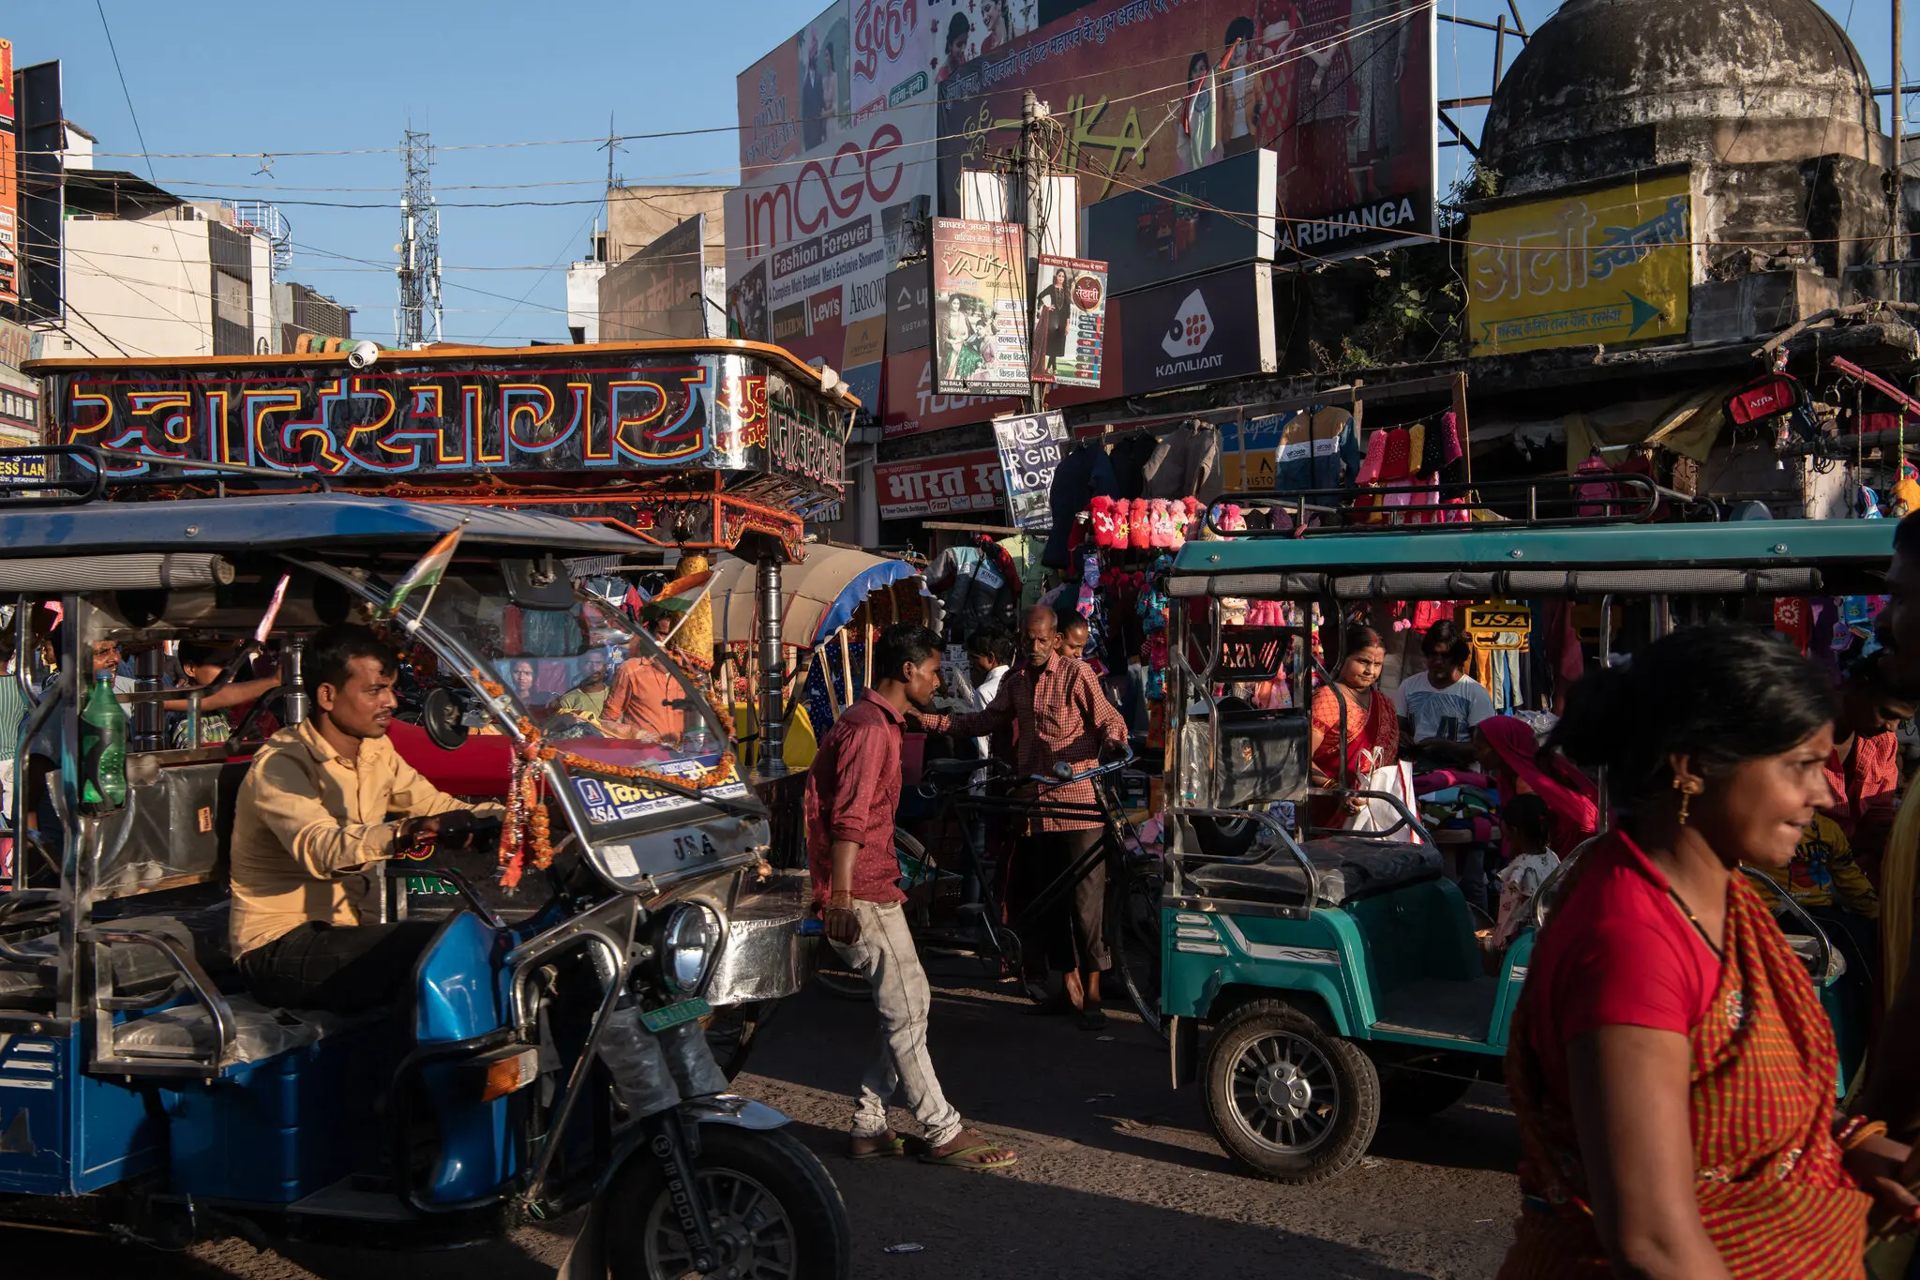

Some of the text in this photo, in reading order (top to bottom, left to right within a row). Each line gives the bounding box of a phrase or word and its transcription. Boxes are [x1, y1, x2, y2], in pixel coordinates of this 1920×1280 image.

[1082, 16, 1094, 43] के
[1094, 12, 1116, 46] शुभ
[774, 221, 870, 277] Fashion Forever
[848, 277, 887, 315] ARROW
[1076, 285, 1099, 301] सेठानी
[1155, 354, 1224, 378] KAMILIANT
[884, 418, 920, 435] Bharat Store
[888, 466, 966, 501] भारत
[1472, 613, 1528, 627] JSA
[590, 804, 620, 823] JSA
[673, 831, 717, 862] JSA
